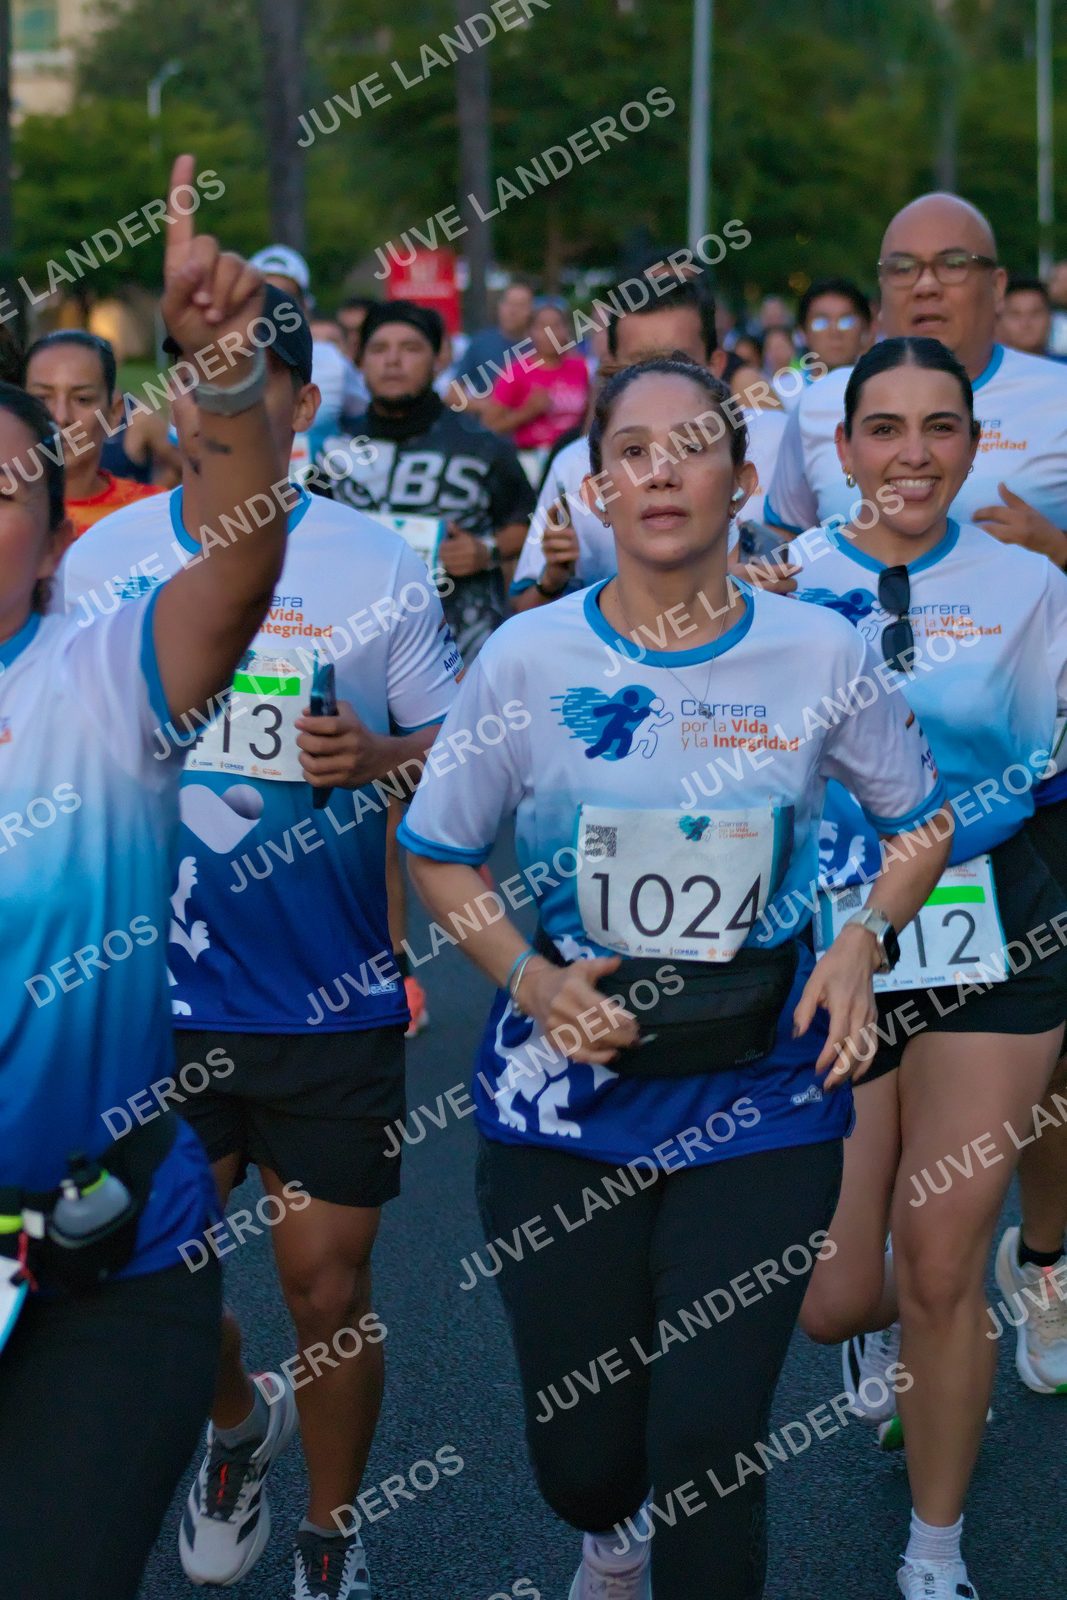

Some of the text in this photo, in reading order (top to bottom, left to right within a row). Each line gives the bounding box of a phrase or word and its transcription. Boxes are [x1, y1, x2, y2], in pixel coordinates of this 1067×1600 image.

[908, 604, 971, 615] arrera
[260, 624, 332, 638] ntegridad
[681, 699, 767, 718] Carrera
[191, 703, 282, 761] 13
[681, 719, 768, 736] por la Vida
[681, 733, 799, 753] y la Integridad
[591, 872, 762, 940] 1024
